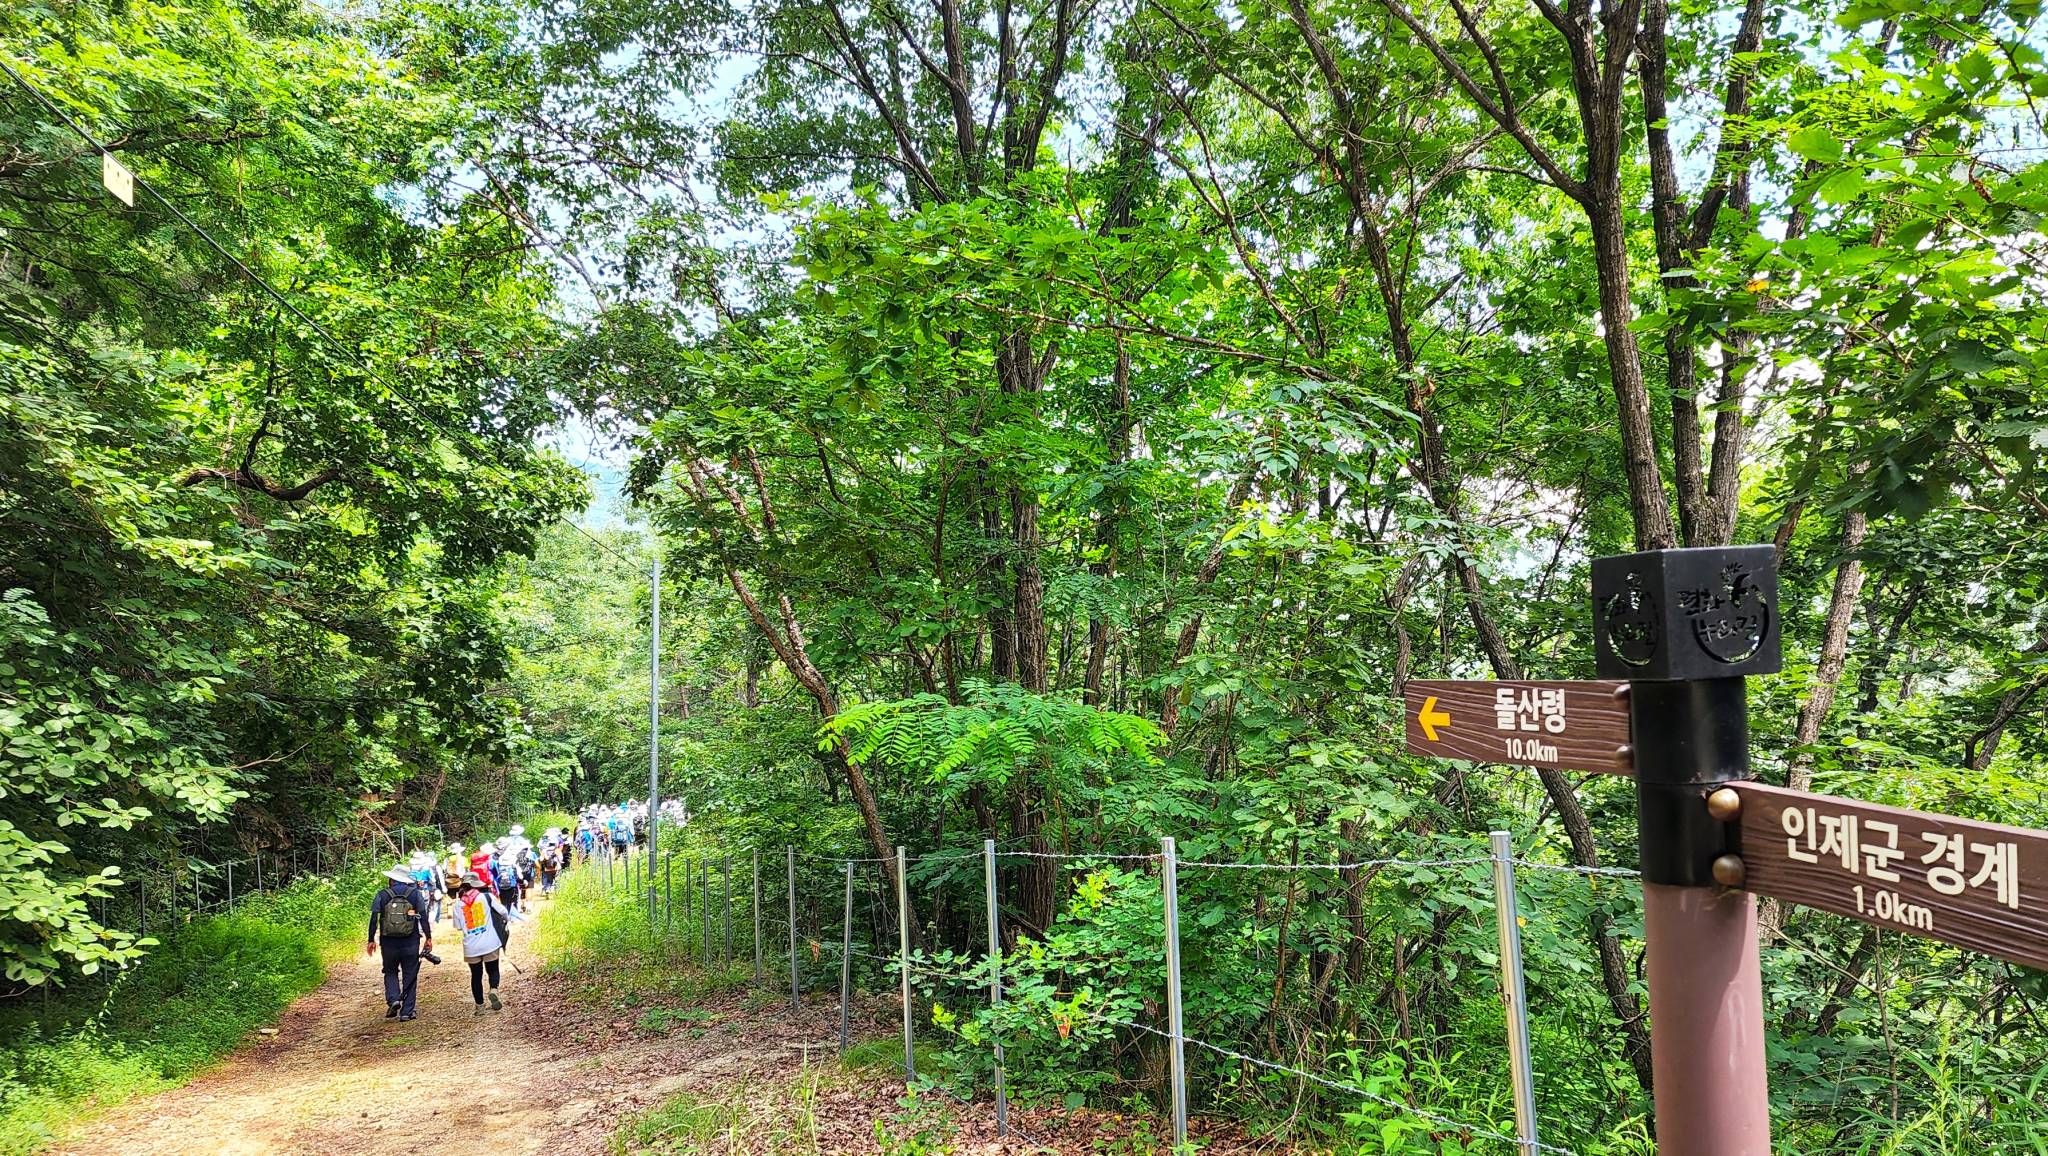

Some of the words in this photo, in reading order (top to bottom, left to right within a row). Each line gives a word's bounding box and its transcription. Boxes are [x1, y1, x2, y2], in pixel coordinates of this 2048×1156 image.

[1494, 688, 1566, 734] 돌산령
[1505, 738, 1559, 763] 10.0km
[1781, 806, 1905, 883] 인제군
[1920, 832, 2019, 910] 경계
[1852, 885, 1934, 931] 1.0km
